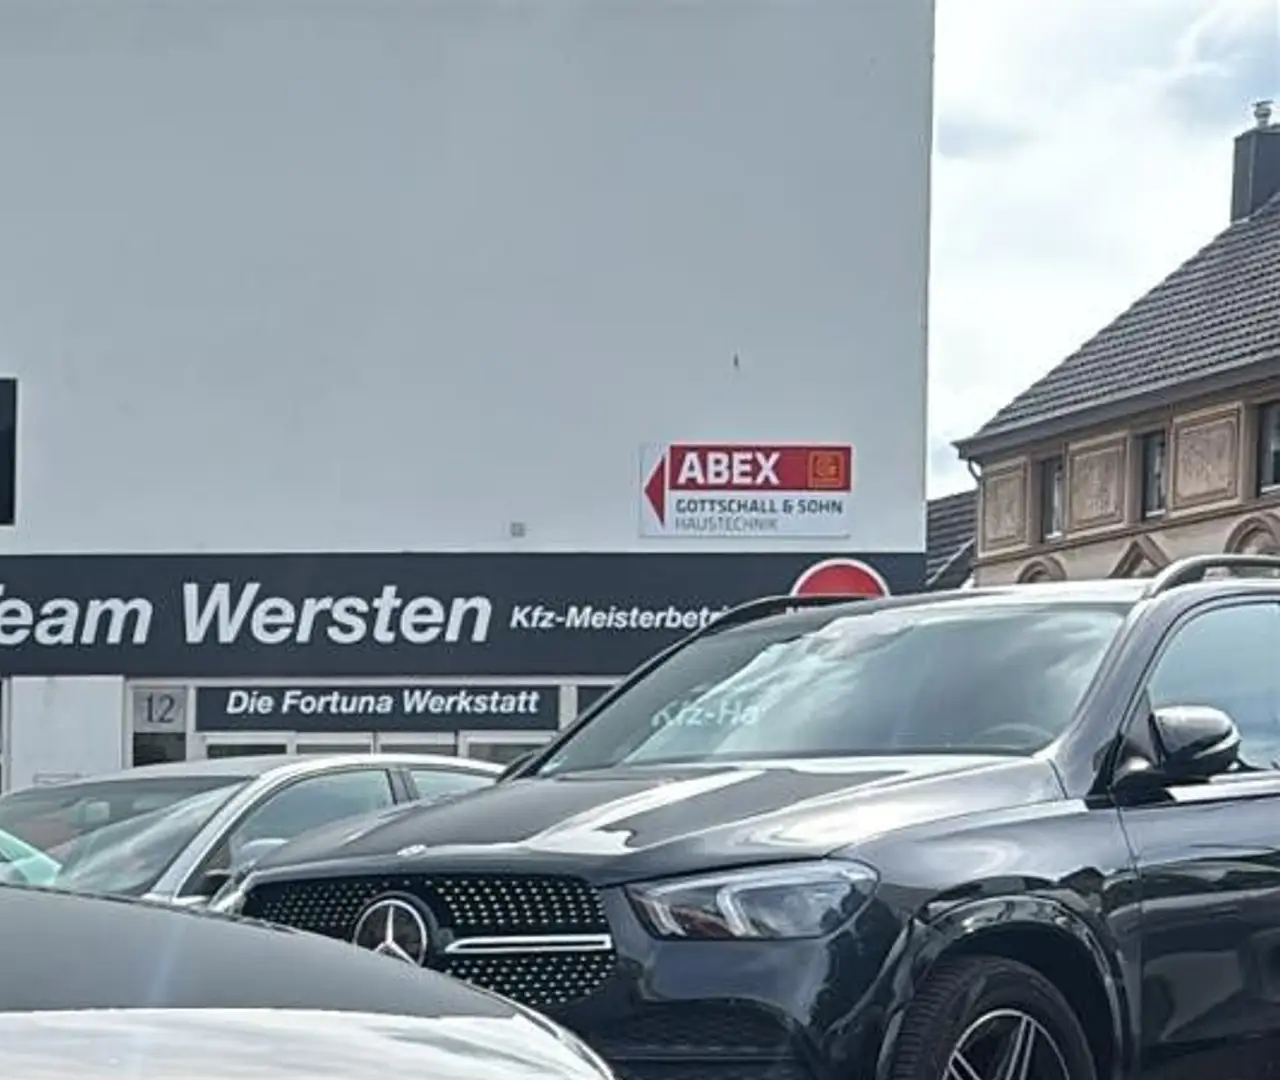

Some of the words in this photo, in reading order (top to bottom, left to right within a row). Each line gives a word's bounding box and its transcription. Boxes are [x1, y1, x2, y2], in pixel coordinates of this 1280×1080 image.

[677, 451, 780, 485] ABEX
[675, 499, 777, 514] GOTTSCHALL
[797, 499, 843, 514] SOHN
[675, 517, 778, 532] HAUSTECHNIK
[180, 582, 492, 645] Wersten
[509, 604, 728, 632] Kfz-Meisterbetr
[146, 693, 174, 723] 12
[226, 689, 272, 716] Die
[280, 689, 393, 716] Fortuna
[401, 689, 539, 716] Werkstatt
